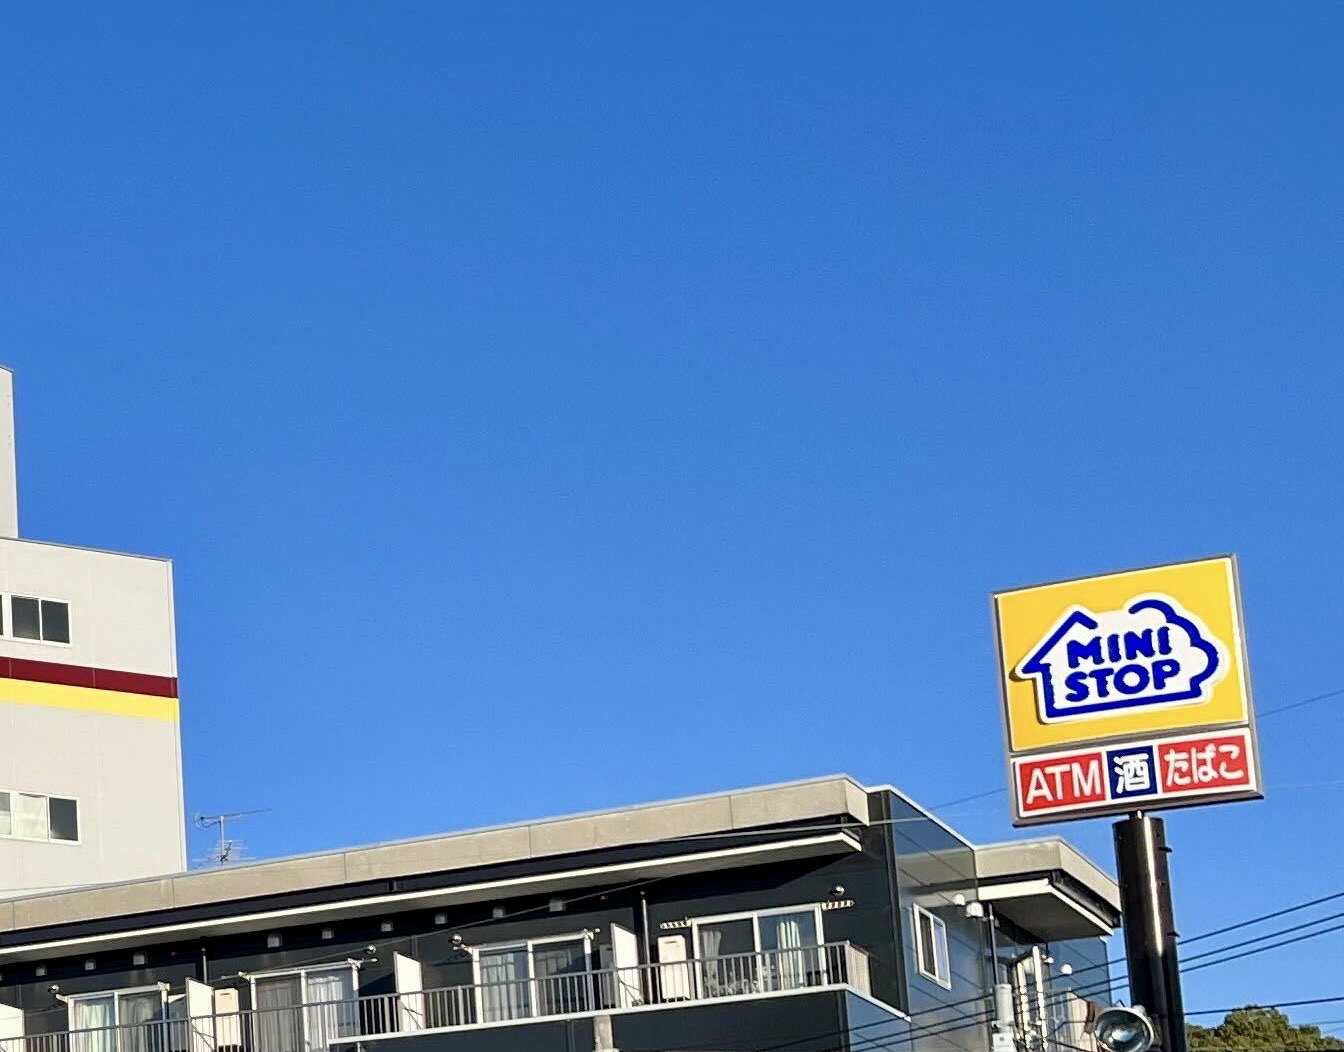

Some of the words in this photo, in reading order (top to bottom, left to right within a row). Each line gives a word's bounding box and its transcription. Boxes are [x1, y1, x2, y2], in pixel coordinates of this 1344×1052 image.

[1066, 625, 1173, 668] MINI
[1064, 658, 1180, 702] STOP
[1025, 758, 1102, 804] ATM
[1113, 752, 1152, 794] 酒
[1164, 743, 1245, 787] たばこ
